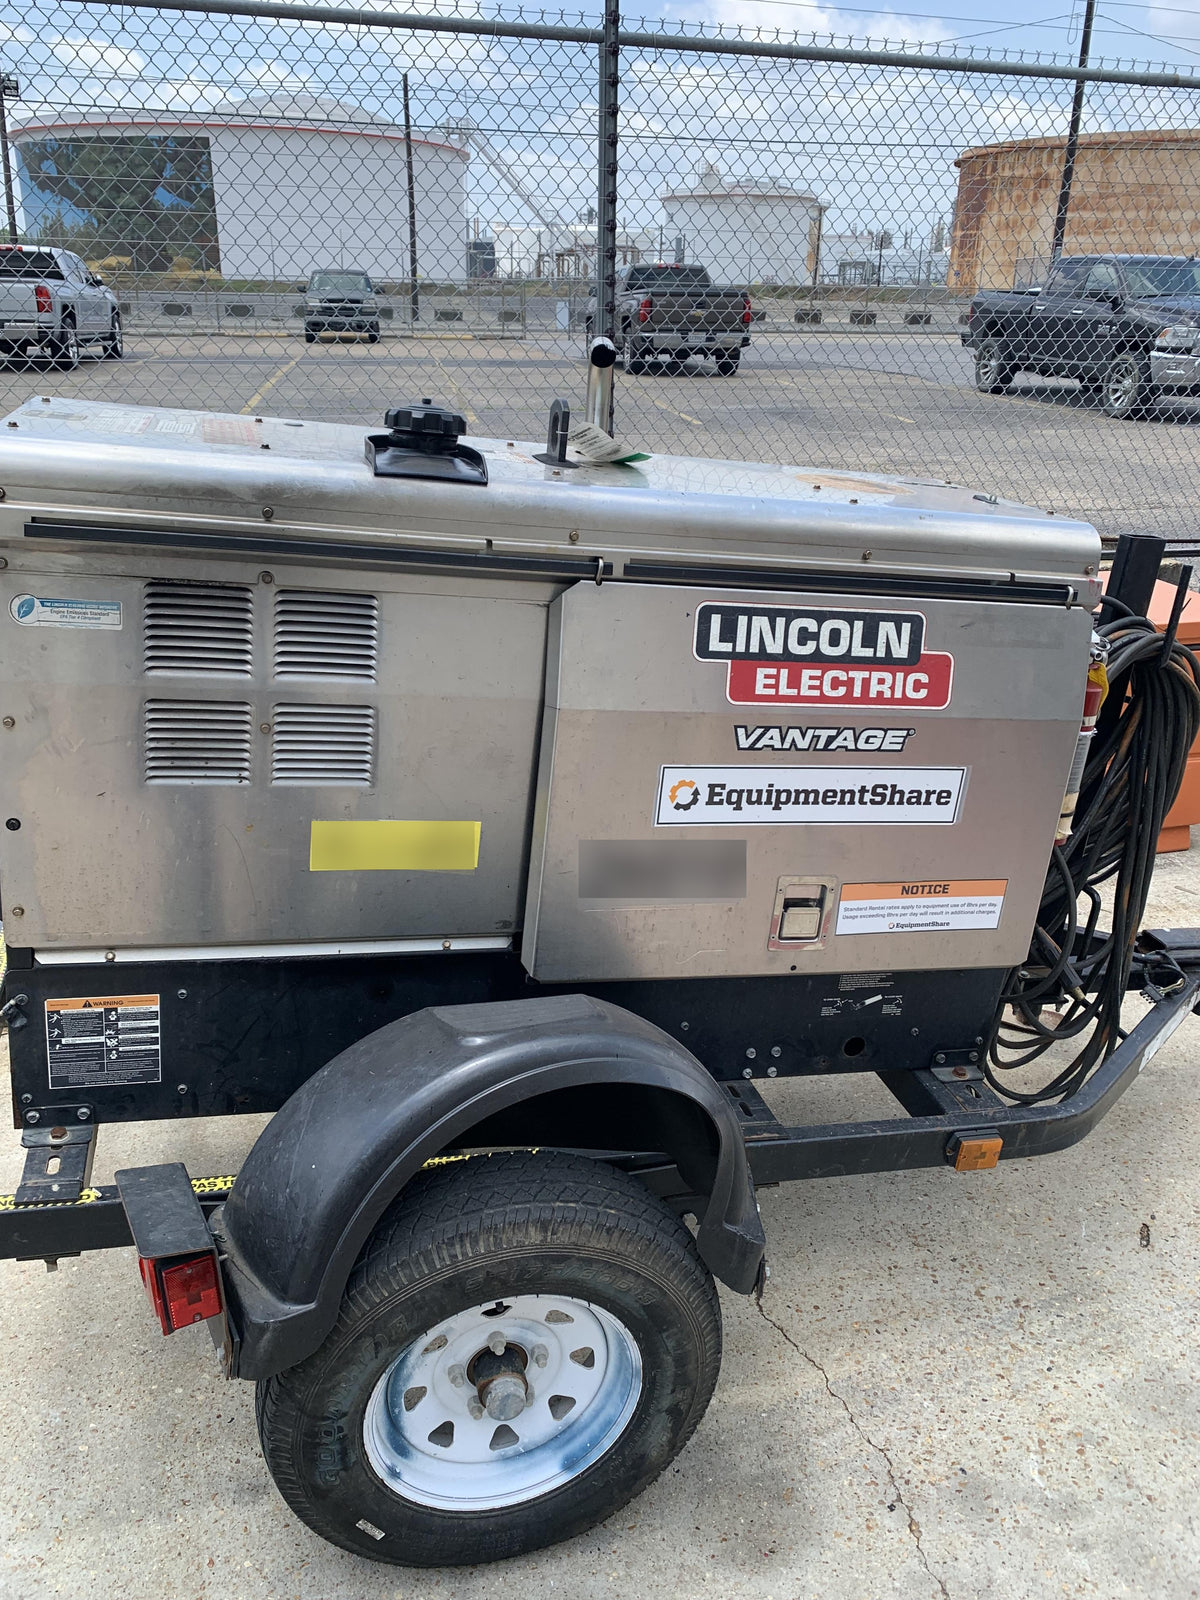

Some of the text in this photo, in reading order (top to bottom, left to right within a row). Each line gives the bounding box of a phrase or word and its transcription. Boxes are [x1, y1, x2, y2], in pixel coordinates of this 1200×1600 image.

[708, 613, 912, 659] LINCOLN
[754, 667, 930, 700] ELECTRIC
[734, 725, 909, 753] VANTAGE
[705, 783, 952, 812] EquipmentShare
[900, 884, 950, 896] NOTICE
[843, 905, 868, 913] Standard
[895, 920, 951, 930] EquipmentShare
[92, 999, 125, 1007] WARNING
